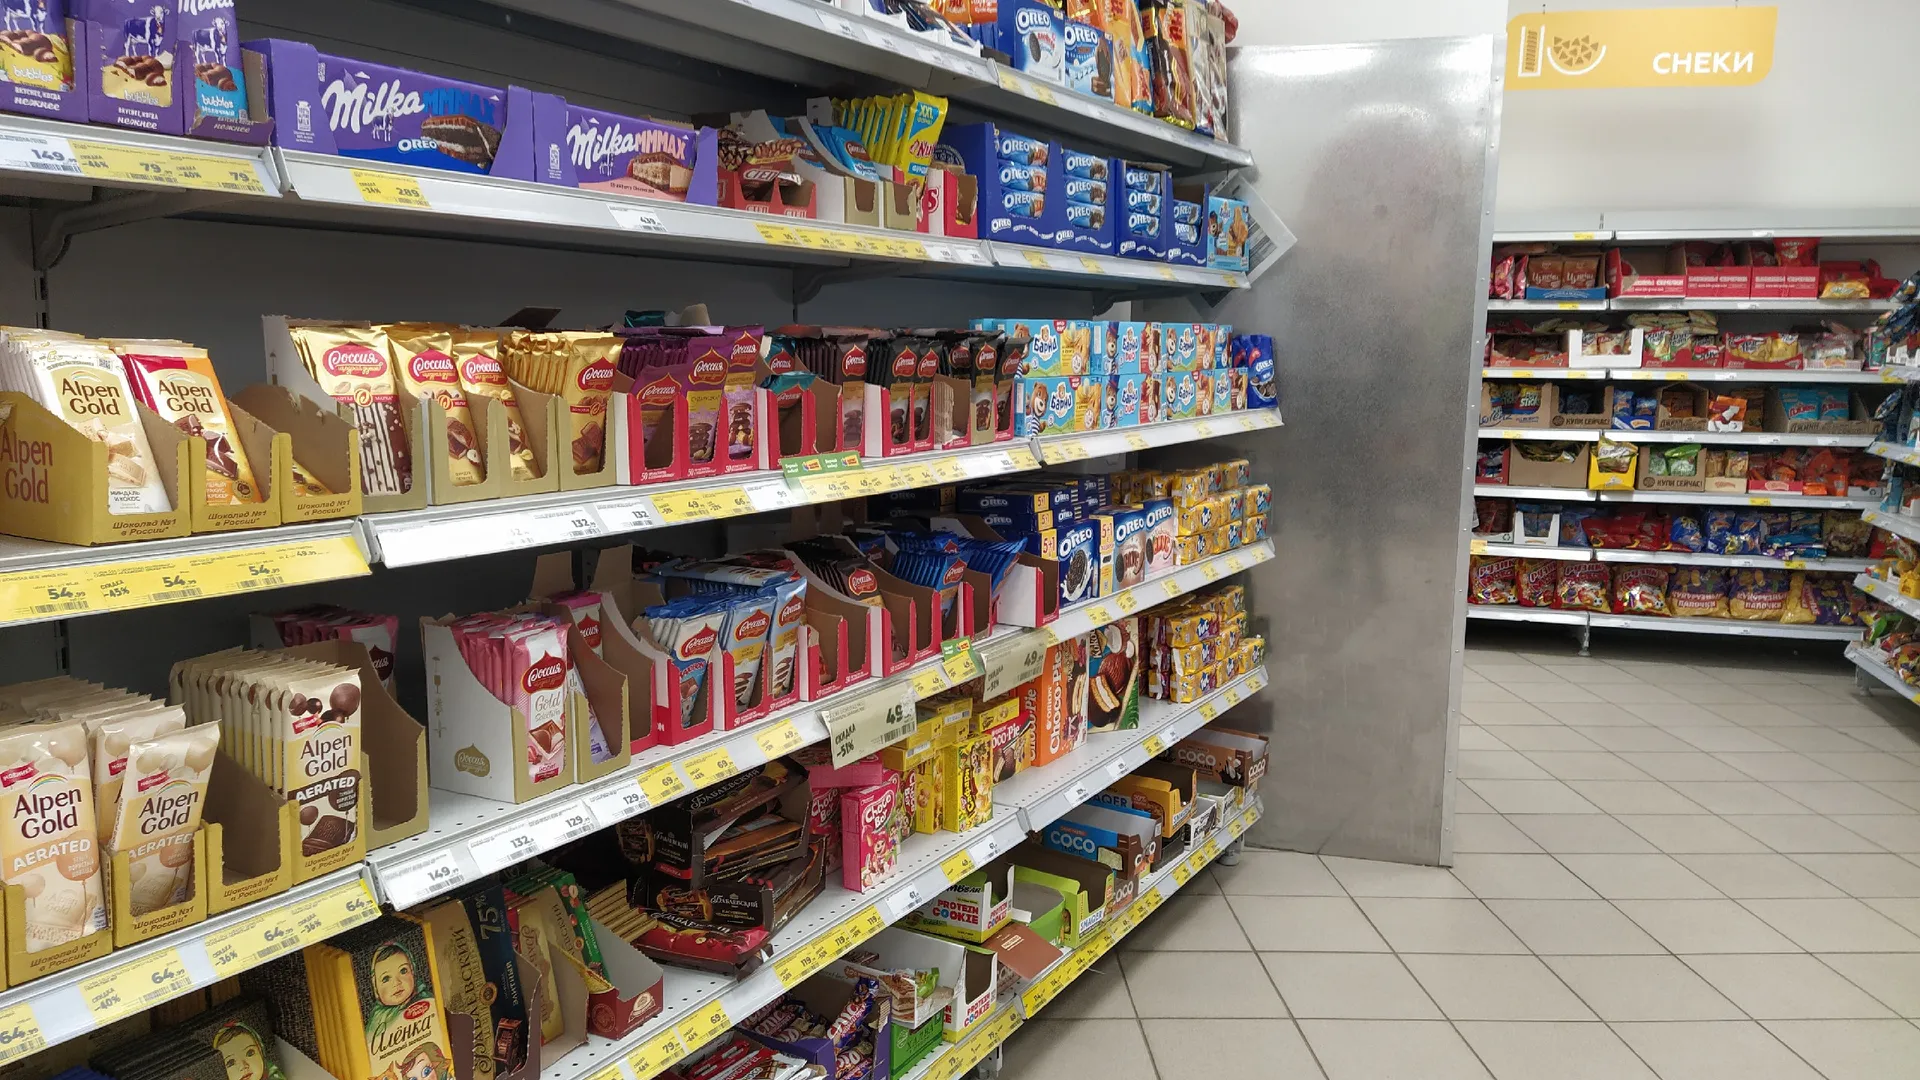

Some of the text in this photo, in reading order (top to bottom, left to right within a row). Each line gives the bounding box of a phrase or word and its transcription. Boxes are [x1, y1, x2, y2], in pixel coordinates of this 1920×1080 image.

[1016, 8, 1050, 27] OREO
[1064, 26, 1098, 44] OREO
[1653, 52, 1754, 74] СНЕКИ
[12, 65, 53, 83] bubbles
[124, 90, 160, 105] bubbles
[202, 94, 234, 109] bubbles
[321, 79, 425, 133] Milka
[398, 138, 437, 152] OREO
[566, 123, 686, 170] Milka MMMAX
[1002, 139, 1031, 154] OREO
[1067, 156, 1092, 171] OREO
[1001, 168, 1030, 182] OREO
[1126, 171, 1150, 186] OREO
[1067, 181, 1092, 195] OREO
[1004, 192, 1032, 209] OREO
[1129, 191, 1152, 205] OREO
[1067, 206, 1092, 220] OREO
[1174, 204, 1193, 218] OREO
[991, 217, 1011, 232] OREO
[1129, 213, 1152, 227] OREO
[1056, 229, 1074, 243] OREO
[1120, 240, 1136, 254] OREO
[1168, 248, 1182, 261] OREO
[731, 343, 757, 359] Россия
[1034, 336, 1057, 354] Барни
[328, 351, 378, 370] Россия
[413, 358, 453, 377] Россия
[466, 362, 501, 379] Россия
[582, 368, 614, 385] Россия
[694, 362, 723, 379] Россия
[62, 378, 120, 400] Alpen
[158, 380, 212, 399] Alpen
[70, 397, 120, 416] Gold
[166, 398, 213, 414] Gold
[1050, 395, 1072, 412] Барни
[1, 427, 53, 473] Alpen
[5, 467, 49, 505] Gold
[208, 511, 248, 520] Шоколад
[297, 503, 333, 511] Шоколад
[632, 510, 648, 519] 132
[113, 520, 158, 530] Шоколад
[572, 519, 588, 528] 132
[1146, 506, 1172, 528] OREO
[1116, 518, 1145, 542] OREO
[1042, 536, 1056, 554] 5+1
[1059, 529, 1093, 556] OREO
[1678, 600, 1717, 609] ПАЛОЧКИ
[1745, 601, 1782, 610] ПАЛОЧКИ
[528, 663, 562, 687] Россия
[535, 691, 561, 712] Gold
[1050, 651, 1062, 755] Choco-Pie
[886, 704, 903, 725] 49
[835, 723, 856, 745] СКИДКА
[300, 734, 352, 759] Alpen
[836, 740, 854, 758] -51%
[304, 751, 348, 777] Gold
[1178, 749, 1216, 767] COCO
[296, 776, 356, 801] AERATED
[14, 788, 82, 819] Alpen
[138, 790, 199, 818] Alpen
[865, 793, 891, 823] Choco
[21, 806, 78, 839] Gold
[141, 806, 190, 835] Gold
[129, 833, 193, 859] AERATED
[1050, 831, 1096, 854] COCO
[13, 838, 91, 872] AERATED
[710, 893, 759, 910] БАБАЕВСКИЙ
[937, 899, 979, 914] PROTEIN
[133, 913, 175, 931] Шоколад
[476, 893, 502, 941] 75%
[867, 917, 877, 925] 119
[932, 907, 979, 924] COOKIE
[264, 927, 293, 942] 64.99
[300, 919, 321, 934] -36%
[835, 936, 845, 945] 119
[30, 950, 73, 968] Шоколад
[215, 951, 238, 967] -36%
[801, 957, 811, 966] 119
[151, 968, 185, 984] 64.99
[92, 988, 115, 1003] СКИДКА
[94, 995, 121, 1011] -40%
[967, 993, 991, 1015] PROTEIN
[710, 1014, 721, 1024] 69
[963, 1003, 991, 1027] COOKIE
[0, 1027, 38, 1044] 64.99
[371, 1018, 431, 1056] Алёнка
[663, 1041, 676, 1053] 79
